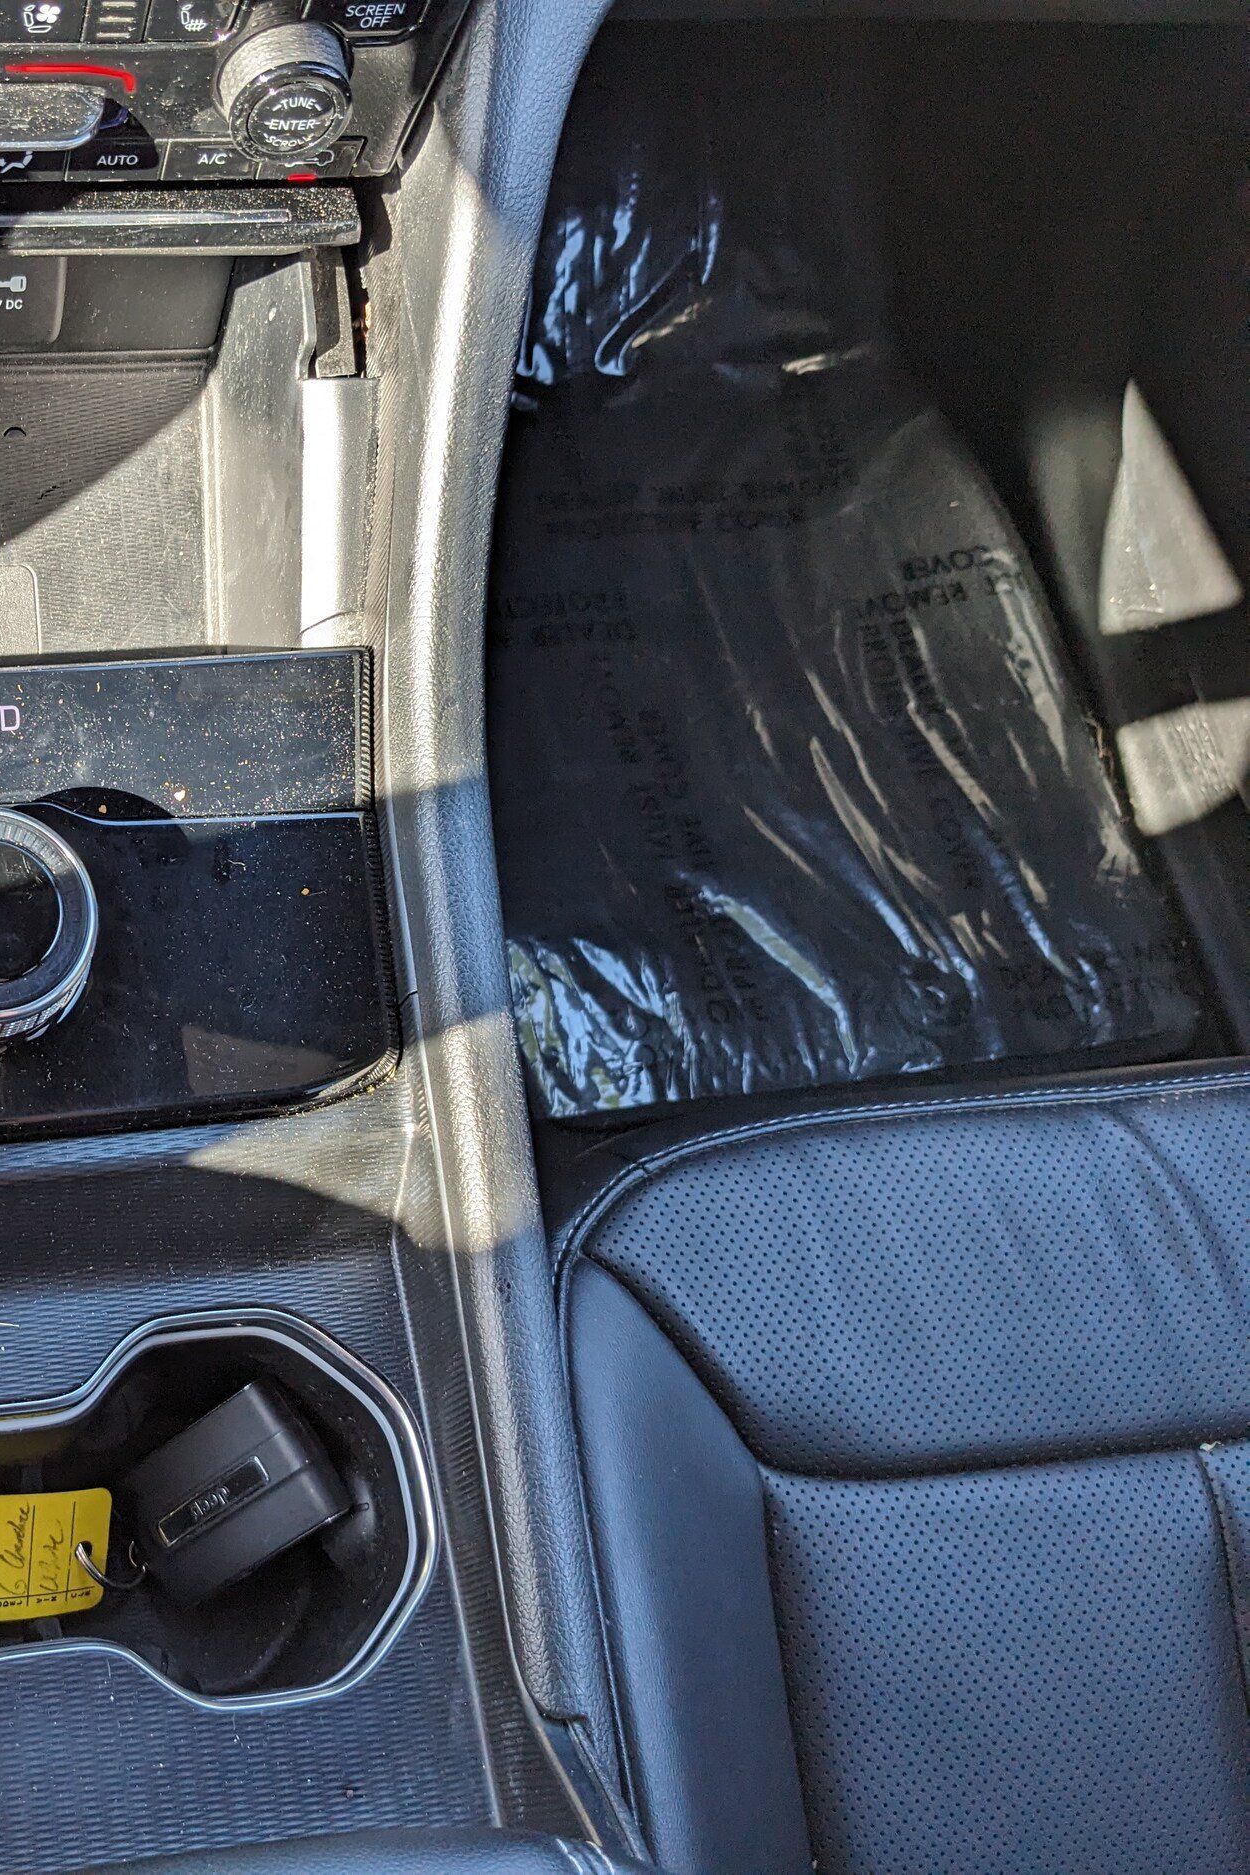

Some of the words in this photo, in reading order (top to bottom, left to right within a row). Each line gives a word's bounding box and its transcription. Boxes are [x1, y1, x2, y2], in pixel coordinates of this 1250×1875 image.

[345, 3, 406, 17] SCREEN
[359, 16, 391, 29] OFF
[281, 97, 316, 110] TUNE
[268, 119, 317, 131] ENTER
[265, 135, 312, 147] SCROLL
[96, 153, 138, 167] AUTO
[198, 152, 226, 166] A/C
[5, 299, 23, 312] DC
[0, 705, 21, 731] D
[36, 1596, 57, 1604] VIN
